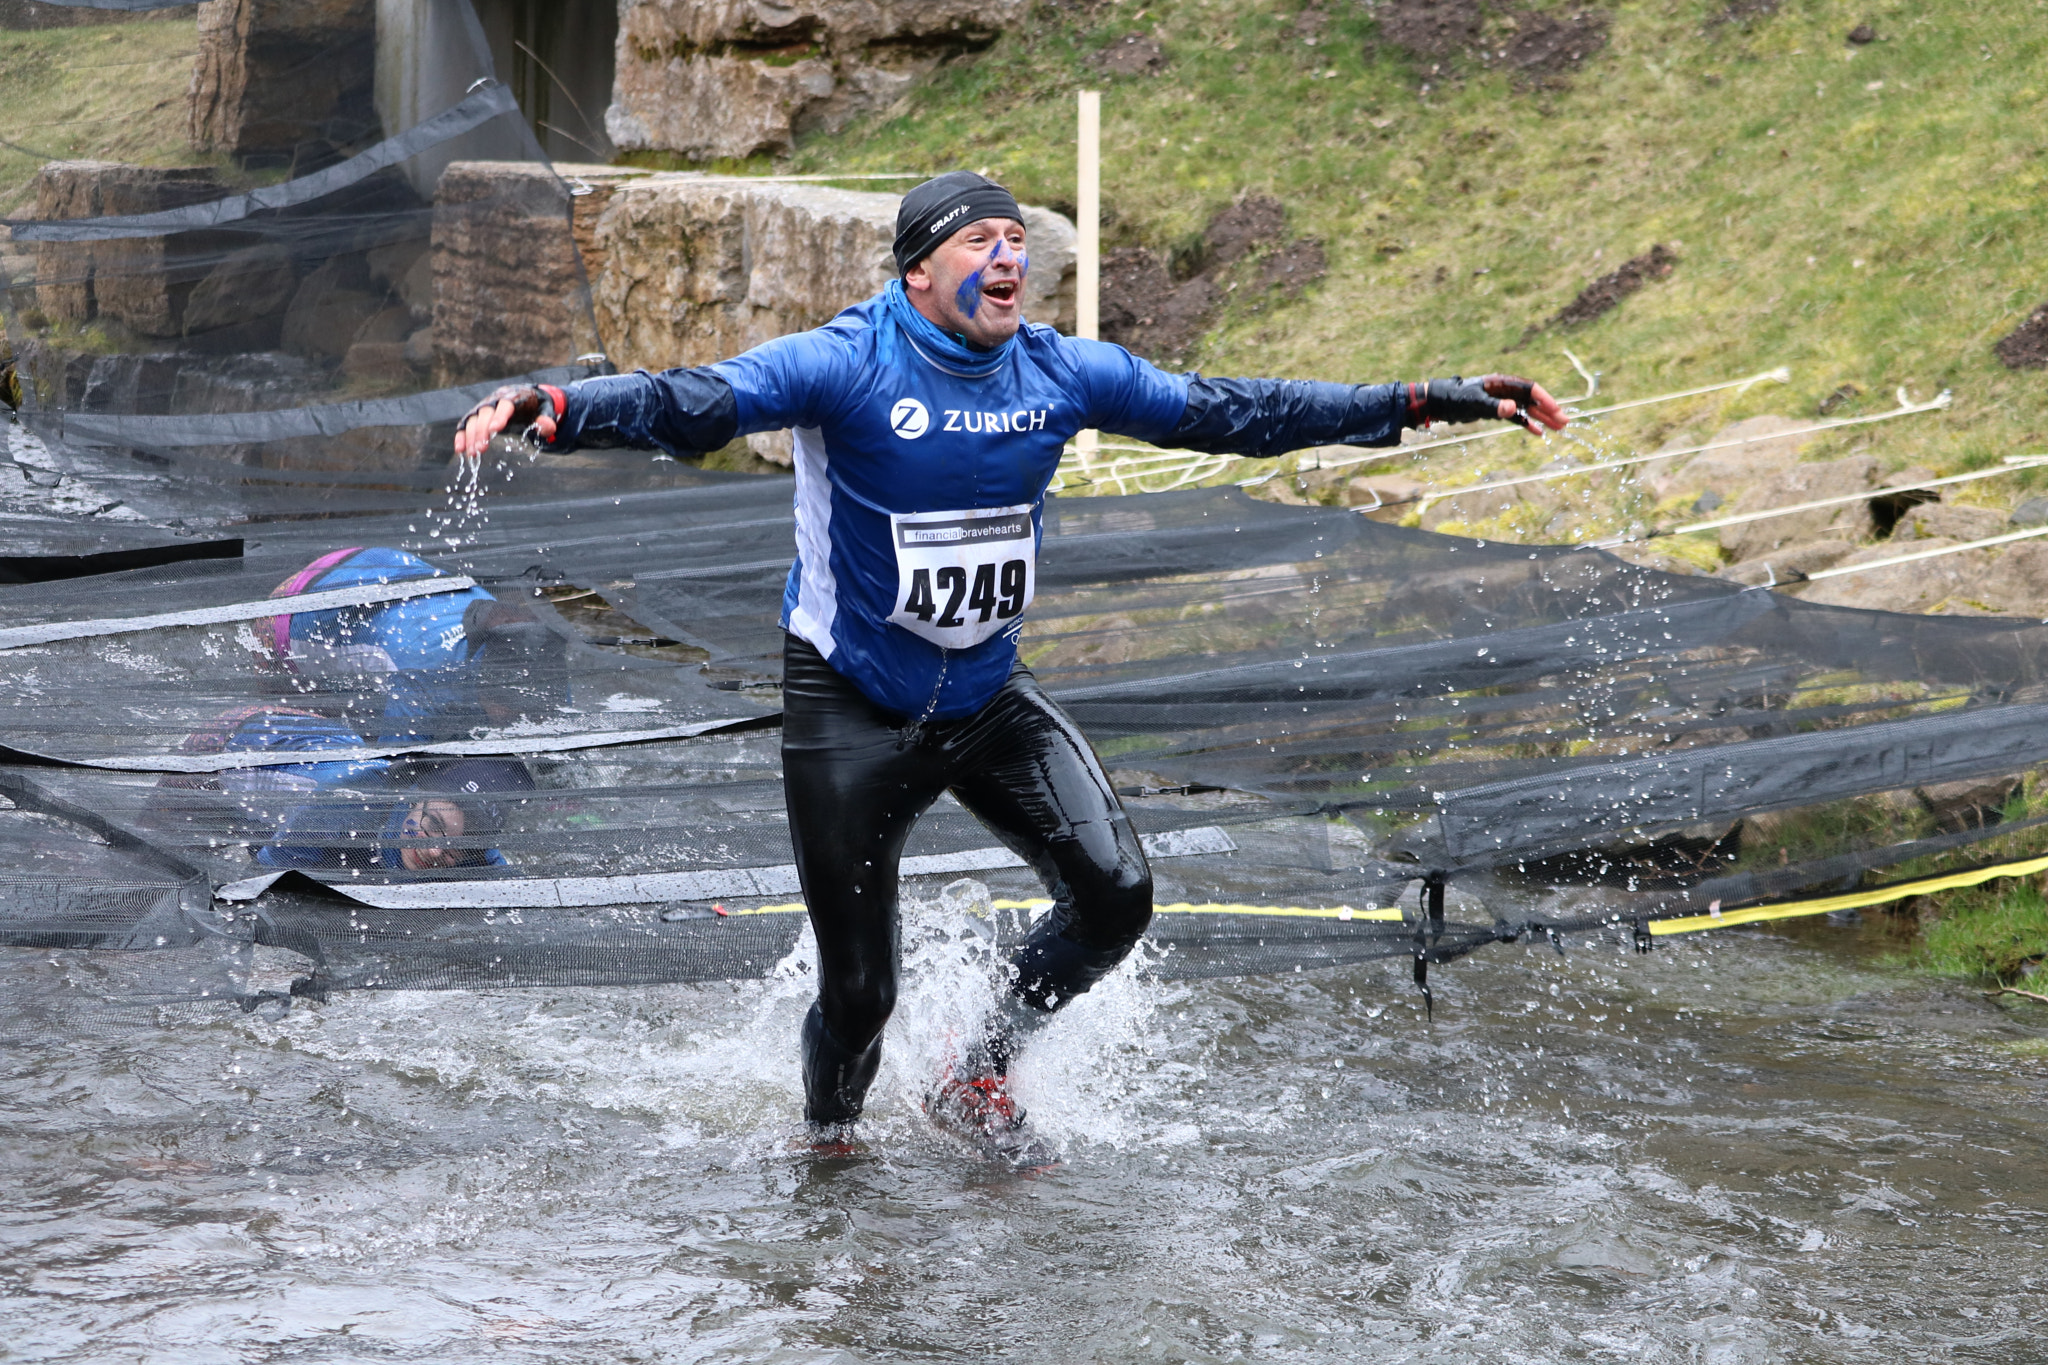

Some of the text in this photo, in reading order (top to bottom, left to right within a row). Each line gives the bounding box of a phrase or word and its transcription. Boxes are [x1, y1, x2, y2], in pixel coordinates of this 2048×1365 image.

[930, 208, 960, 234] CRAFT
[894, 405, 1047, 433] Z ZURICH
[914, 522, 1022, 541] financialbravehearts
[904, 559, 1027, 627] 4249
